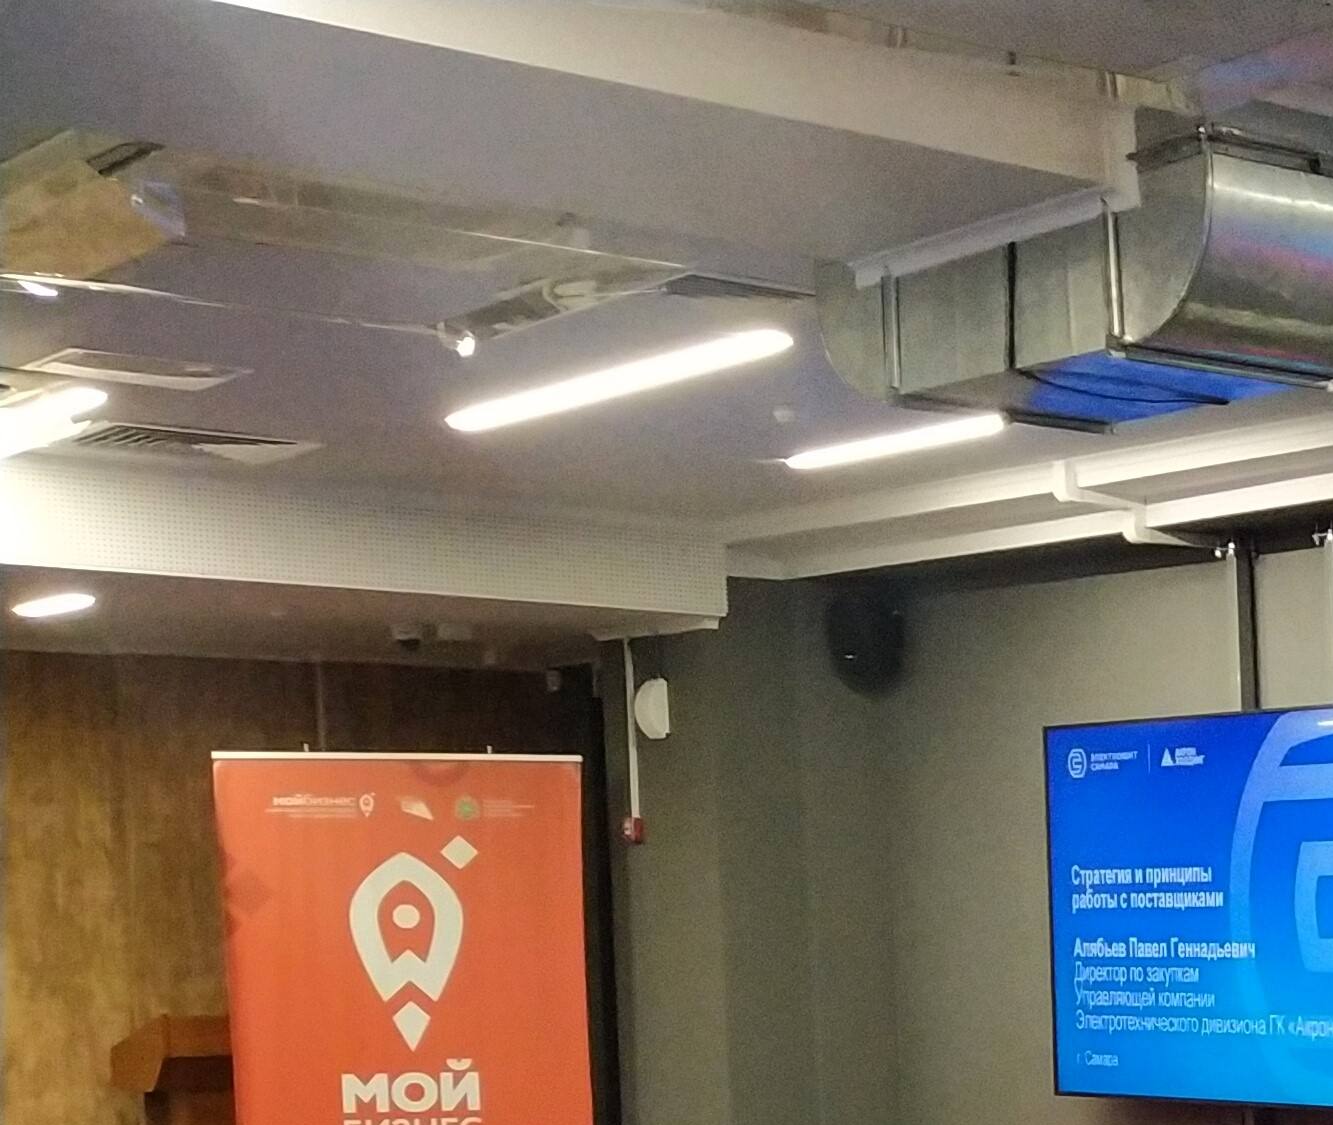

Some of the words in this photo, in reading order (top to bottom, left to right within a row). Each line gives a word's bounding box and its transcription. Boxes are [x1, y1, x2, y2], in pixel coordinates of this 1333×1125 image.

[1071, 865, 1133, 889] Стратегия
[1134, 867, 1143, 884] и
[1146, 866, 1212, 888] принципы
[1071, 889, 1118, 914] работы
[1119, 892, 1128, 909] с
[1130, 891, 1224, 911] поставщиками
[1073, 937, 1127, 958] Алябьев
[1129, 937, 1167, 958] Павел
[1170, 937, 1256, 960] Геннадьевич
[1075, 961, 1127, 987] Директор
[1129, 966, 1144, 983] по
[1146, 966, 1200, 987] закупкам
[1074, 978, 1156, 1010] Управляющей
[1158, 991, 1216, 1008] компании
[1269, 1014, 1286, 1035] ГК
[341, 1058, 481, 1113] МОЙ
